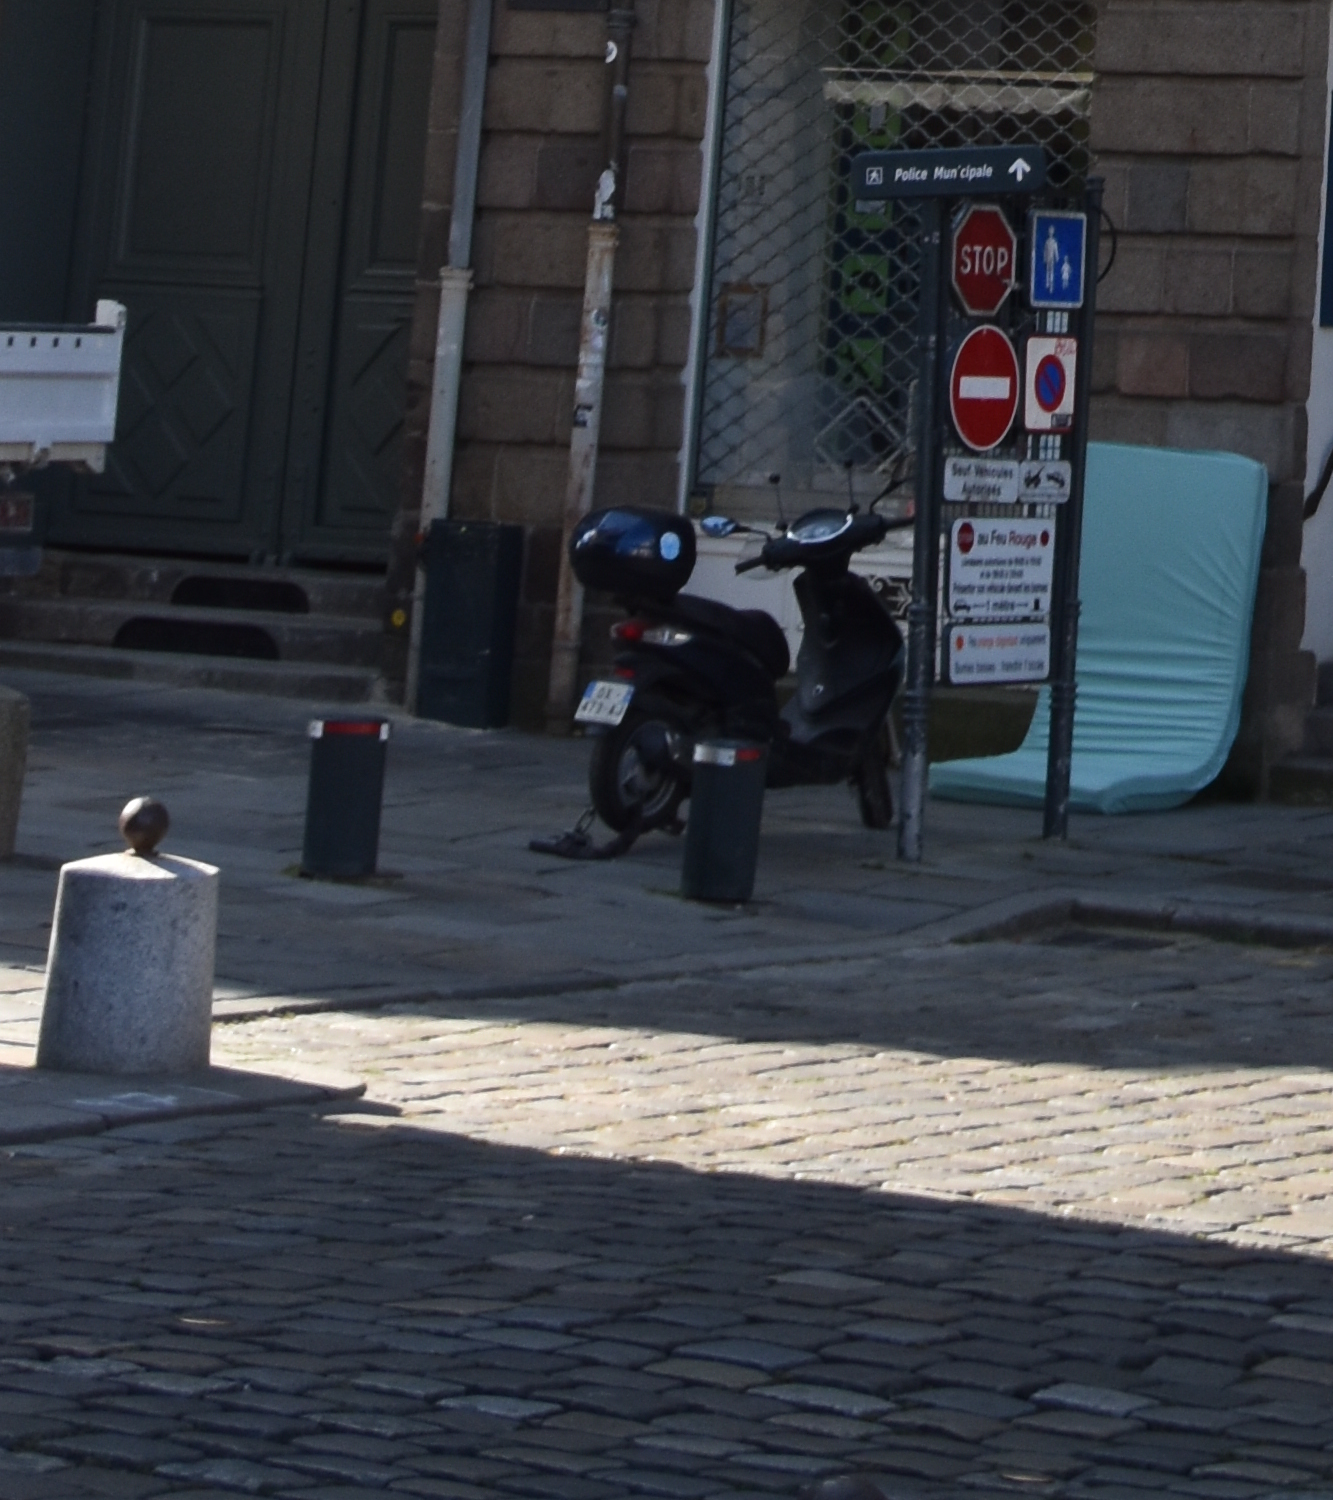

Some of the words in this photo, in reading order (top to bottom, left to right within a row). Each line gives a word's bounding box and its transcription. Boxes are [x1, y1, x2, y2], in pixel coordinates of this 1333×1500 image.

[894, 167, 928, 182] Police
[960, 245, 1009, 276] STOP
[952, 462, 972, 477] Sauf
[977, 533, 989, 545] au
[990, 529, 1007, 545] Feu
[1008, 530, 1037, 550] Rouge
